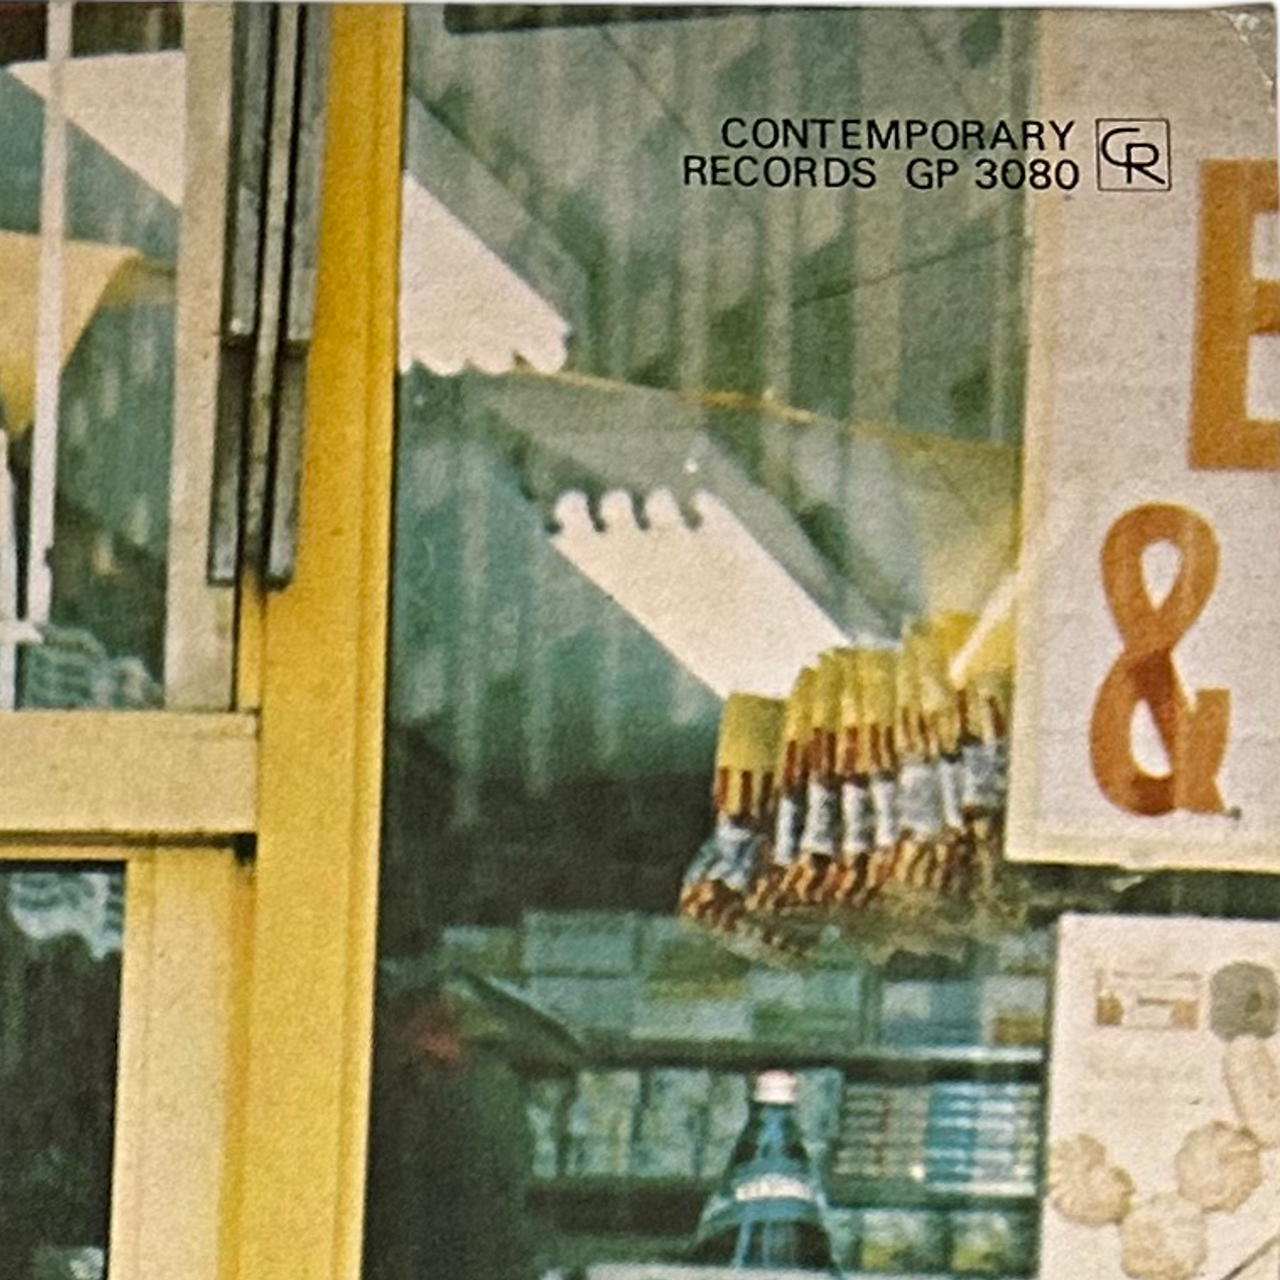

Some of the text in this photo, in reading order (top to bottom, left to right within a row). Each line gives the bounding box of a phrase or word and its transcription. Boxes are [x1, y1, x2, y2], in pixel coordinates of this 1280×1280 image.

[720, 116, 1077, 152] CONTEMPORARY
[682, 154, 1081, 191] RECORDS GP 3080
[1089, 502, 1232, 817] &
